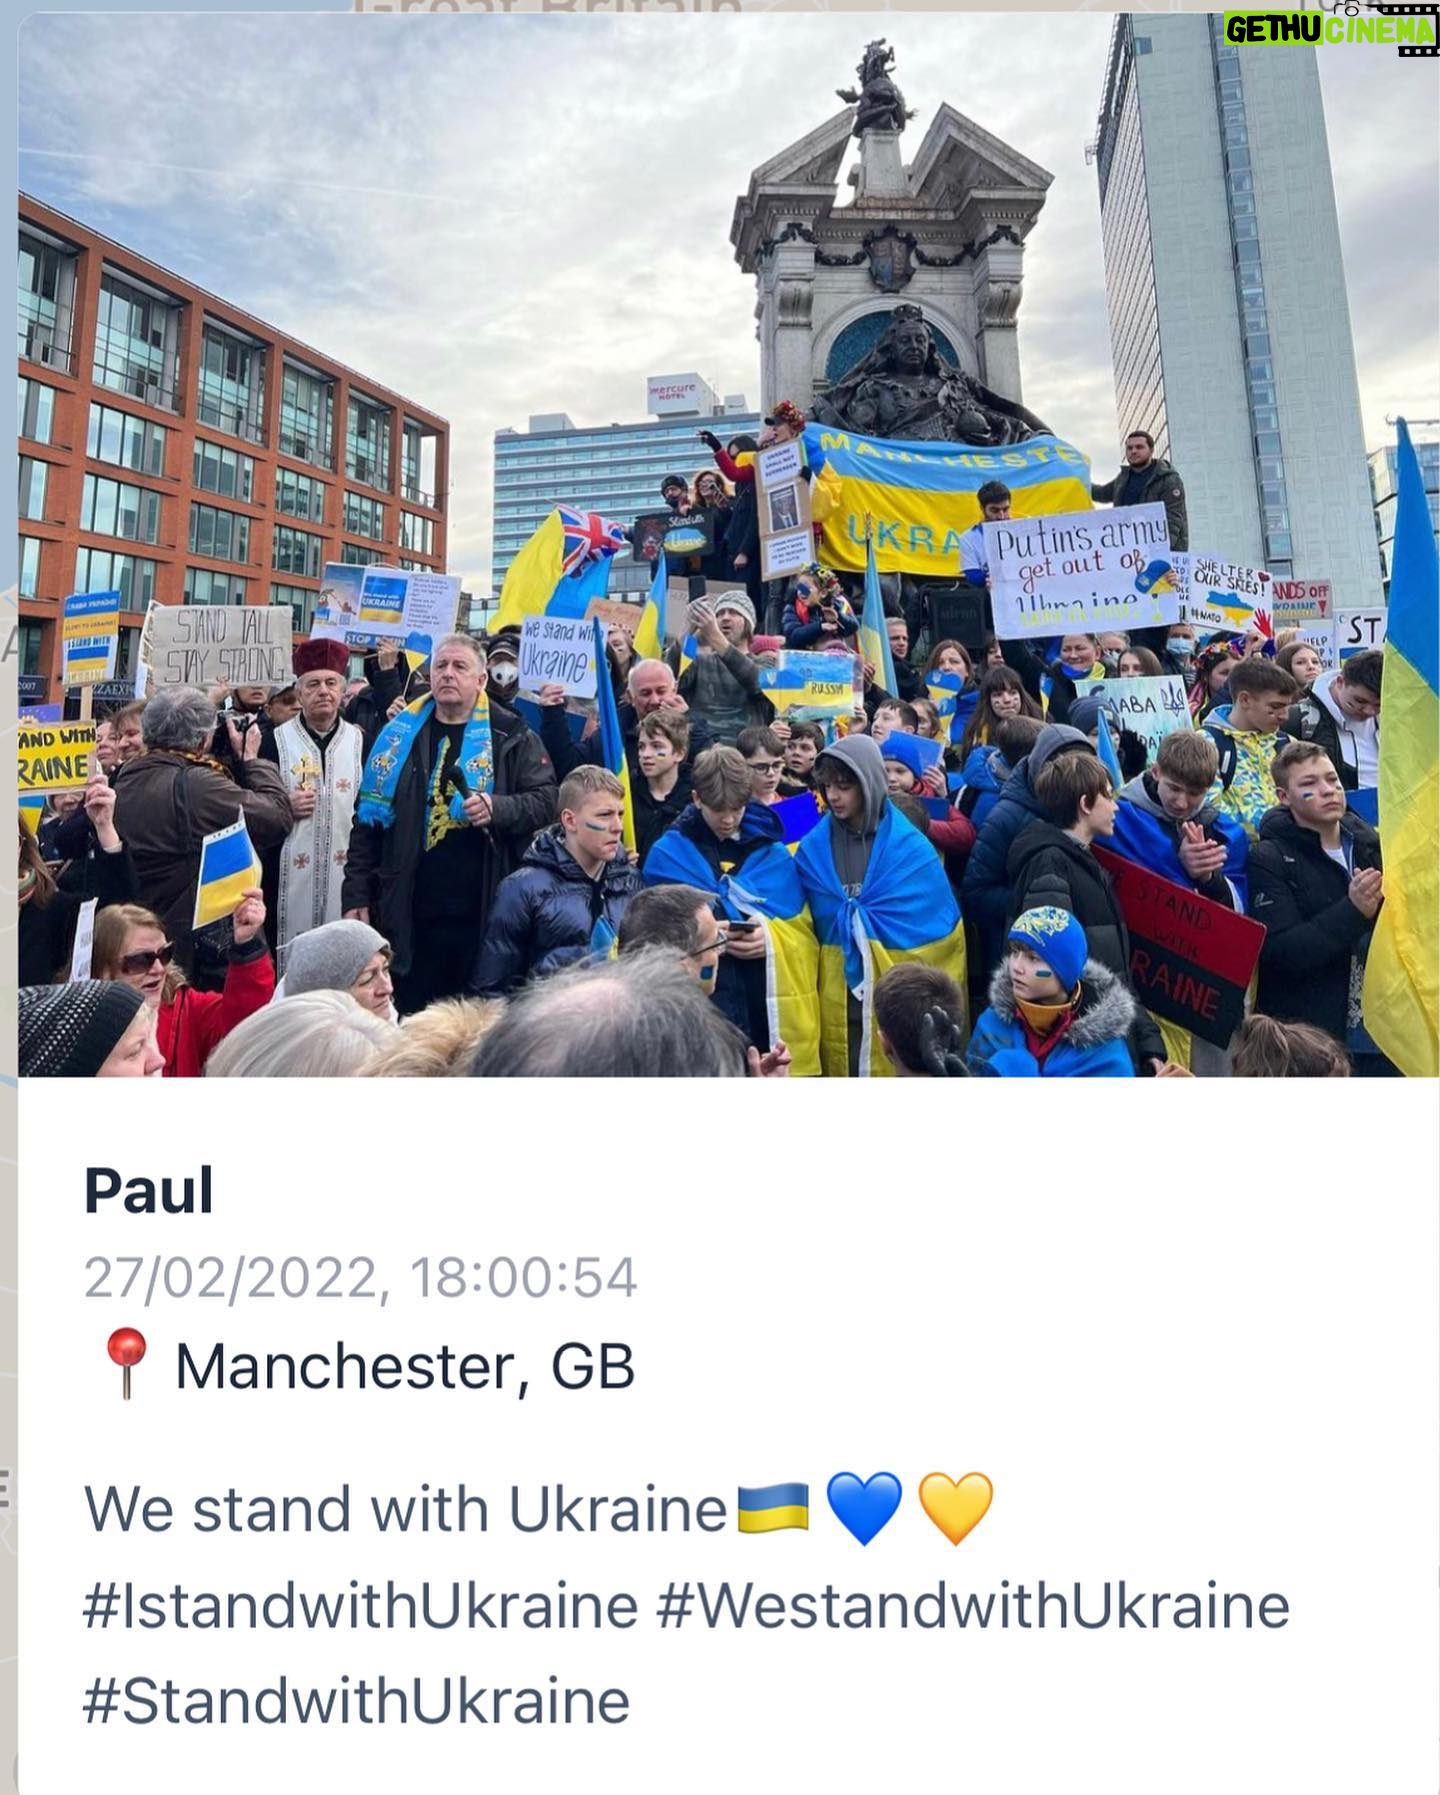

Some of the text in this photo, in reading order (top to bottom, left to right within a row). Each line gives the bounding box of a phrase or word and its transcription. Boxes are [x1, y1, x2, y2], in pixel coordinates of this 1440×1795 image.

[997, 518, 1168, 560] Putin's army
[1019, 559, 1056, 593] get
[1062, 550, 1106, 574] out
[1194, 567, 1221, 586] OUR
[1197, 559, 1254, 580] SHELTER
[362, 597, 401, 608] UKRAINE
[1191, 608, 1222, 623] #NATO
[173, 609, 273, 645] STAND TALL
[345, 634, 371, 646] STOP
[164, 647, 285, 683] STAY STRONG
[522, 642, 588, 684] Ukraine
[60, 728, 96, 744] WITH
[1131, 879, 1213, 930] STAND
